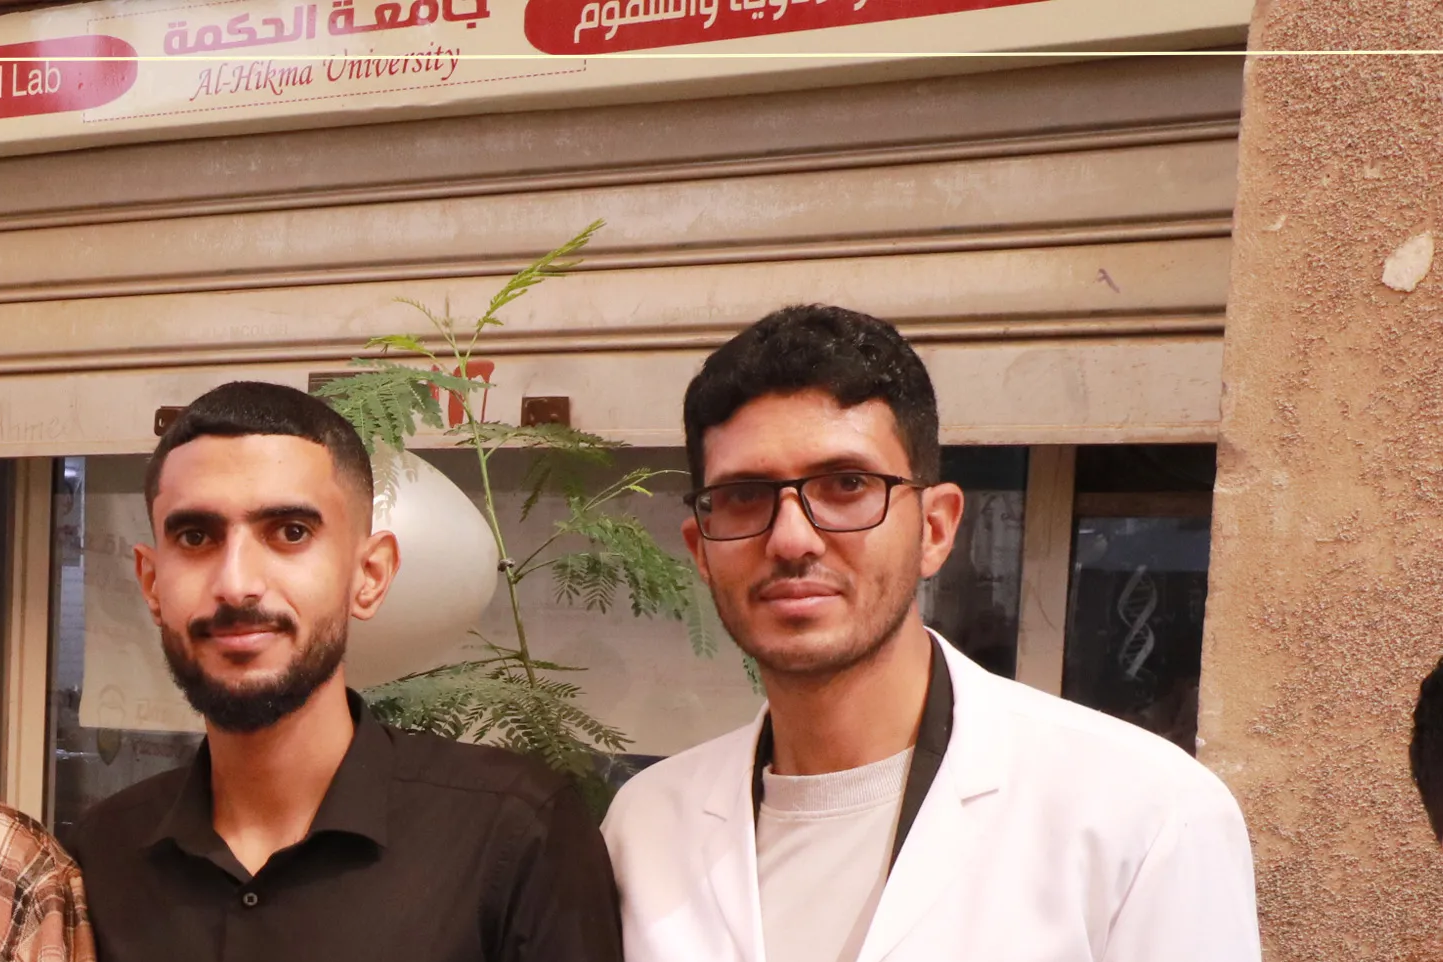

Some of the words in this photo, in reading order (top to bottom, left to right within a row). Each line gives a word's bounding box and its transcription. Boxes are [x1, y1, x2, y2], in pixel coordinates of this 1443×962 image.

[163, 0, 318, 56] الحكمة
[12, 60, 61, 97] Lab
[189, 55, 313, 102] Al-Hikma
[323, 42, 461, 82] University
